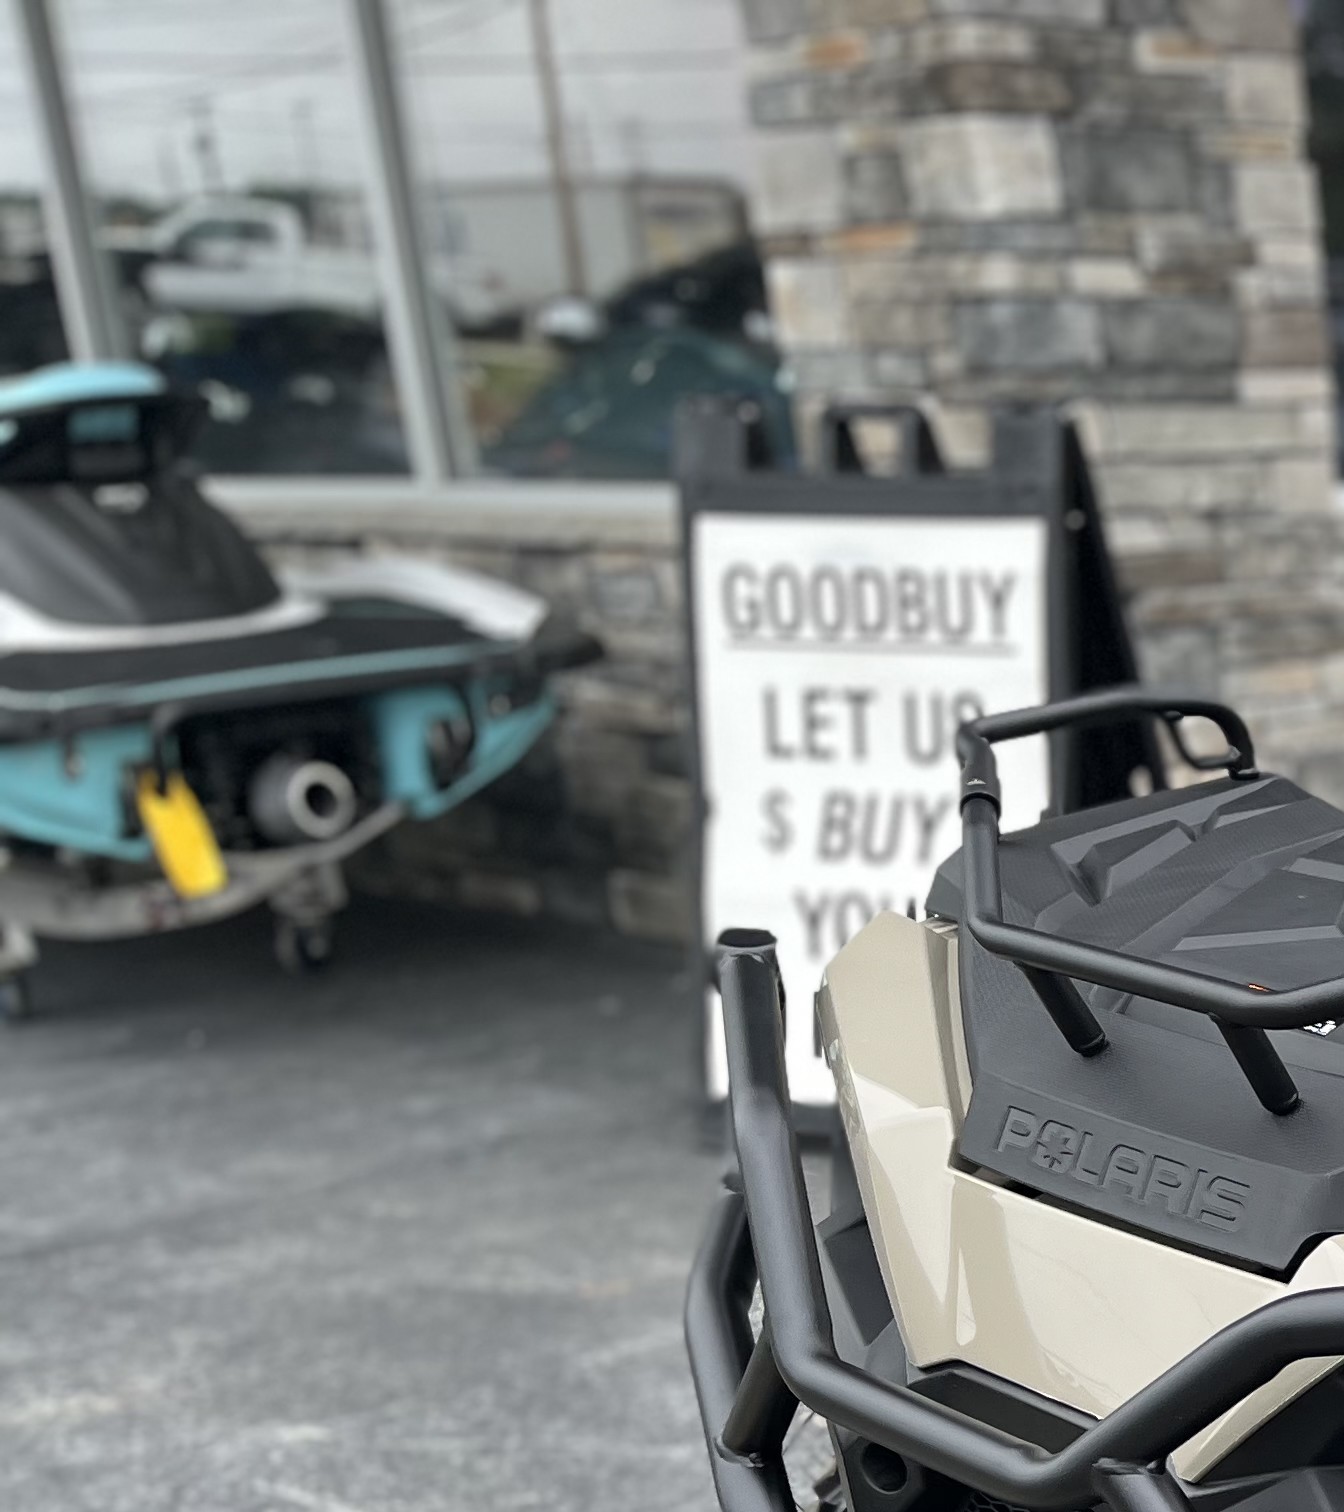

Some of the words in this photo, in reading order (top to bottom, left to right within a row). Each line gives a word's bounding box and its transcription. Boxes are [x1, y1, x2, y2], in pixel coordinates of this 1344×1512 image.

[721, 563, 1018, 644] GOODBUY
[762, 685, 876, 763] LET
[815, 788, 954, 867] BUY
[995, 1104, 1251, 1234] POLARIS
